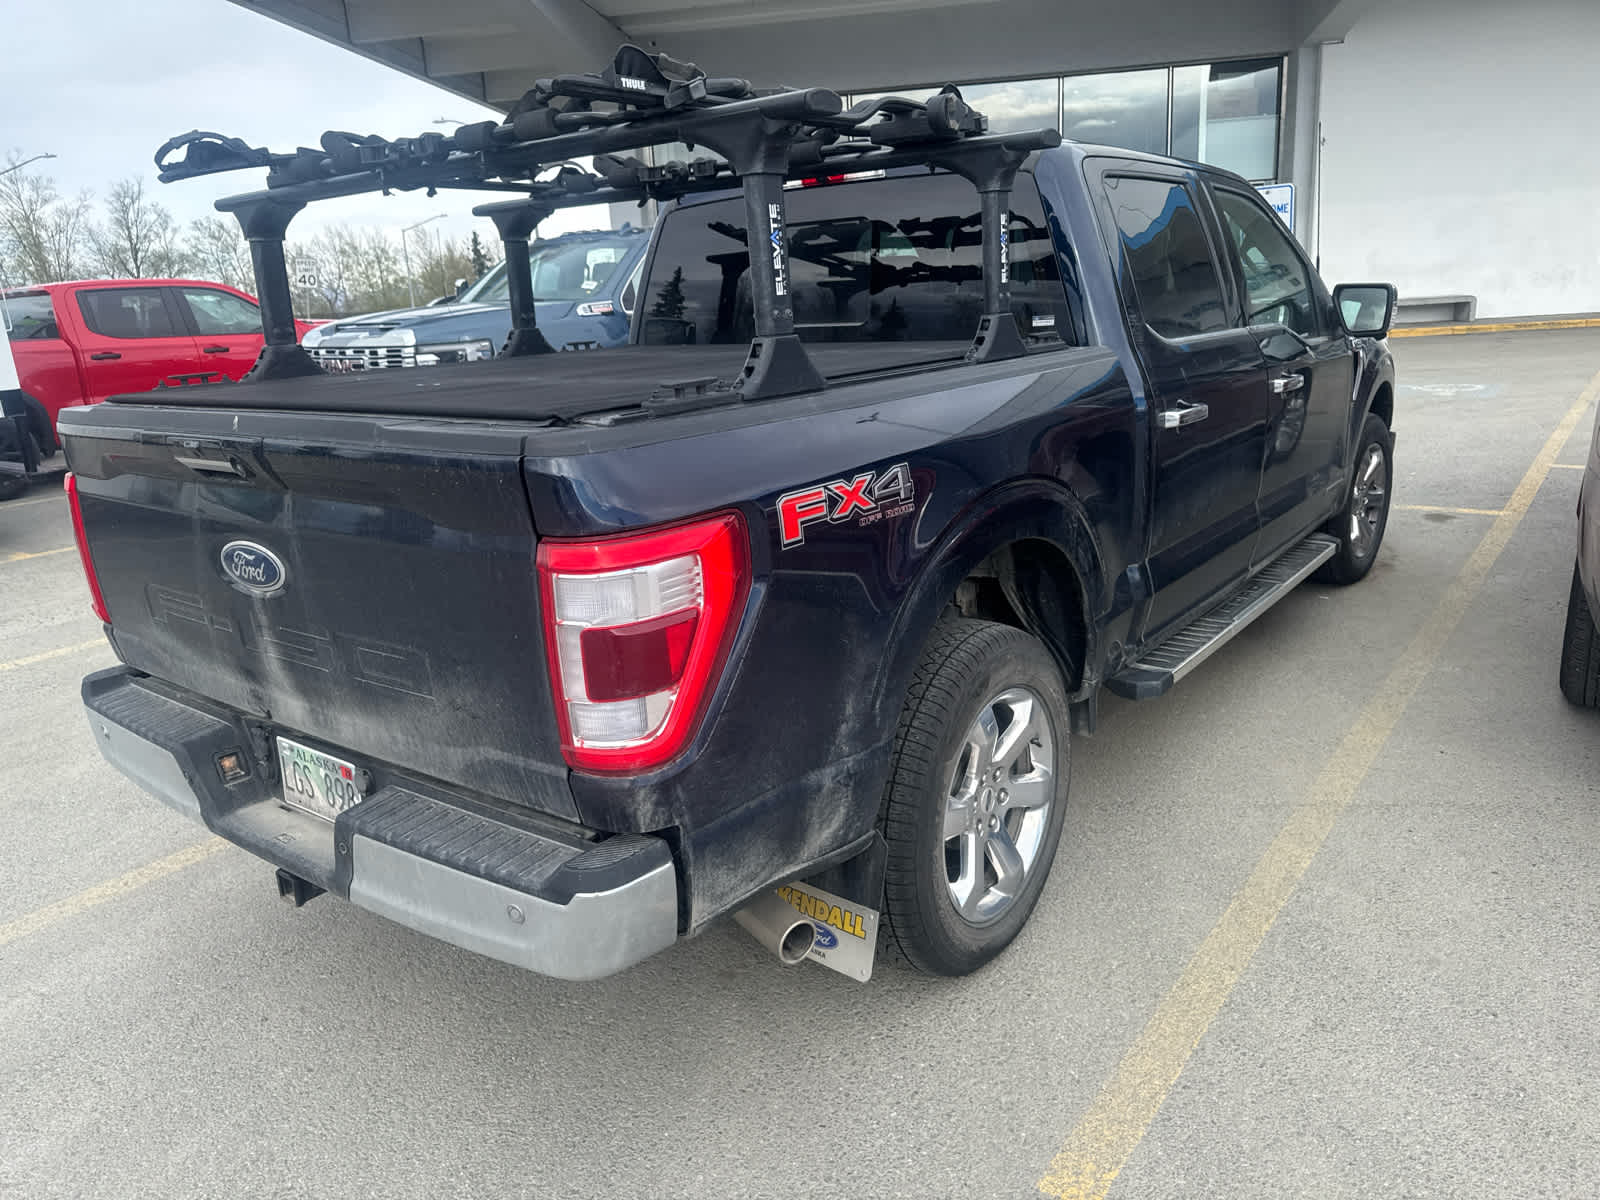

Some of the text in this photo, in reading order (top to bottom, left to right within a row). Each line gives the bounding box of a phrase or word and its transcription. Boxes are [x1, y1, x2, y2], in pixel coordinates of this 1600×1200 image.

[620, 77, 646, 90] THULE
[768, 203, 784, 296] ELEVATE
[298, 274, 317, 286] 40
[776, 461, 915, 551] FX4
[232, 550, 266, 582] Ford
[281, 754, 315, 799] LGS
[295, 748, 338, 774] ALASKA
[777, 885, 867, 941] KENDALL
